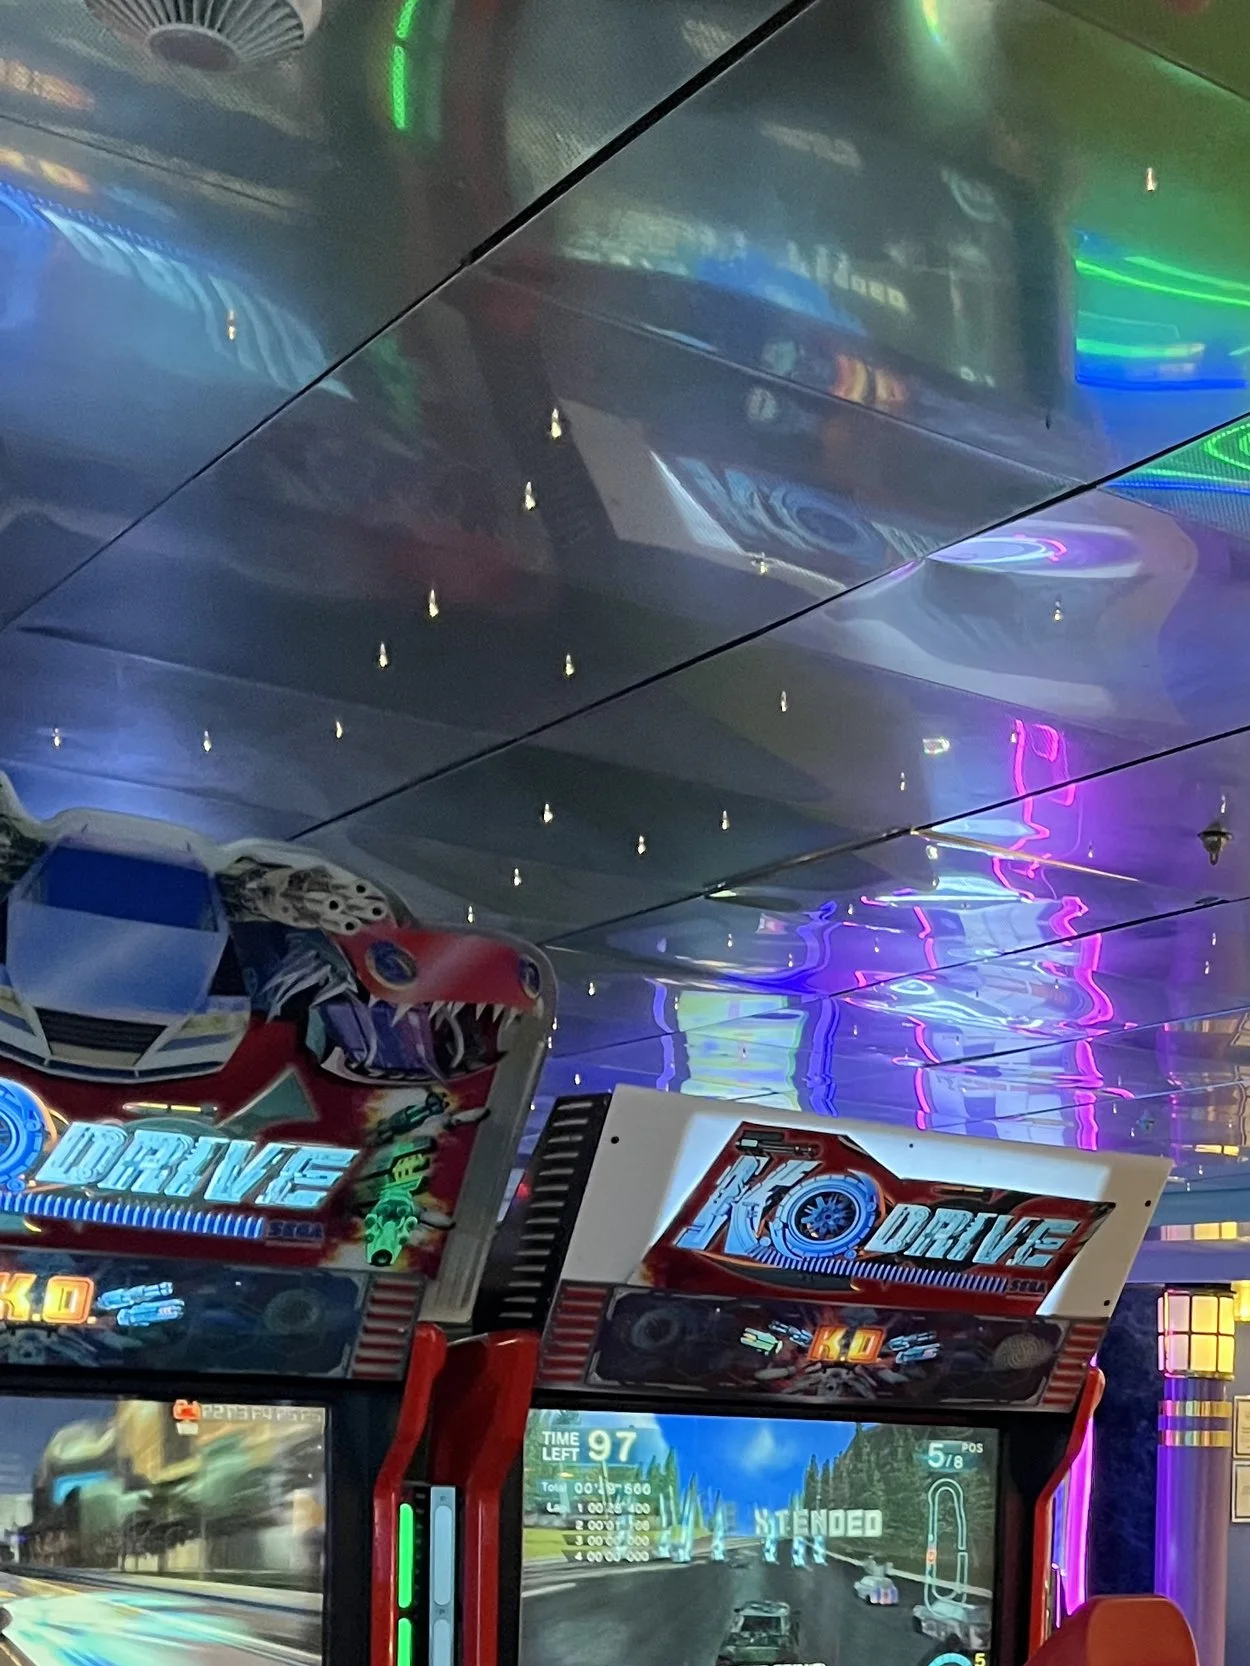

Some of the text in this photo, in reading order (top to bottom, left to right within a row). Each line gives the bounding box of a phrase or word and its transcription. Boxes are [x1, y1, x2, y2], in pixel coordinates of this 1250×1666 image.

[36, 1121, 361, 1208] DRIVE
[267, 1221, 324, 1240] SEGA
[864, 1203, 1083, 1268] DRIVE
[542, 1431, 579, 1446] TIME
[588, 1430, 637, 1462] 97
[542, 1447, 580, 1462] LEFT
[928, 1442, 964, 1469] 5/8
[962, 1443, 984, 1454] POS
[541, 1482, 567, 1493] Total
